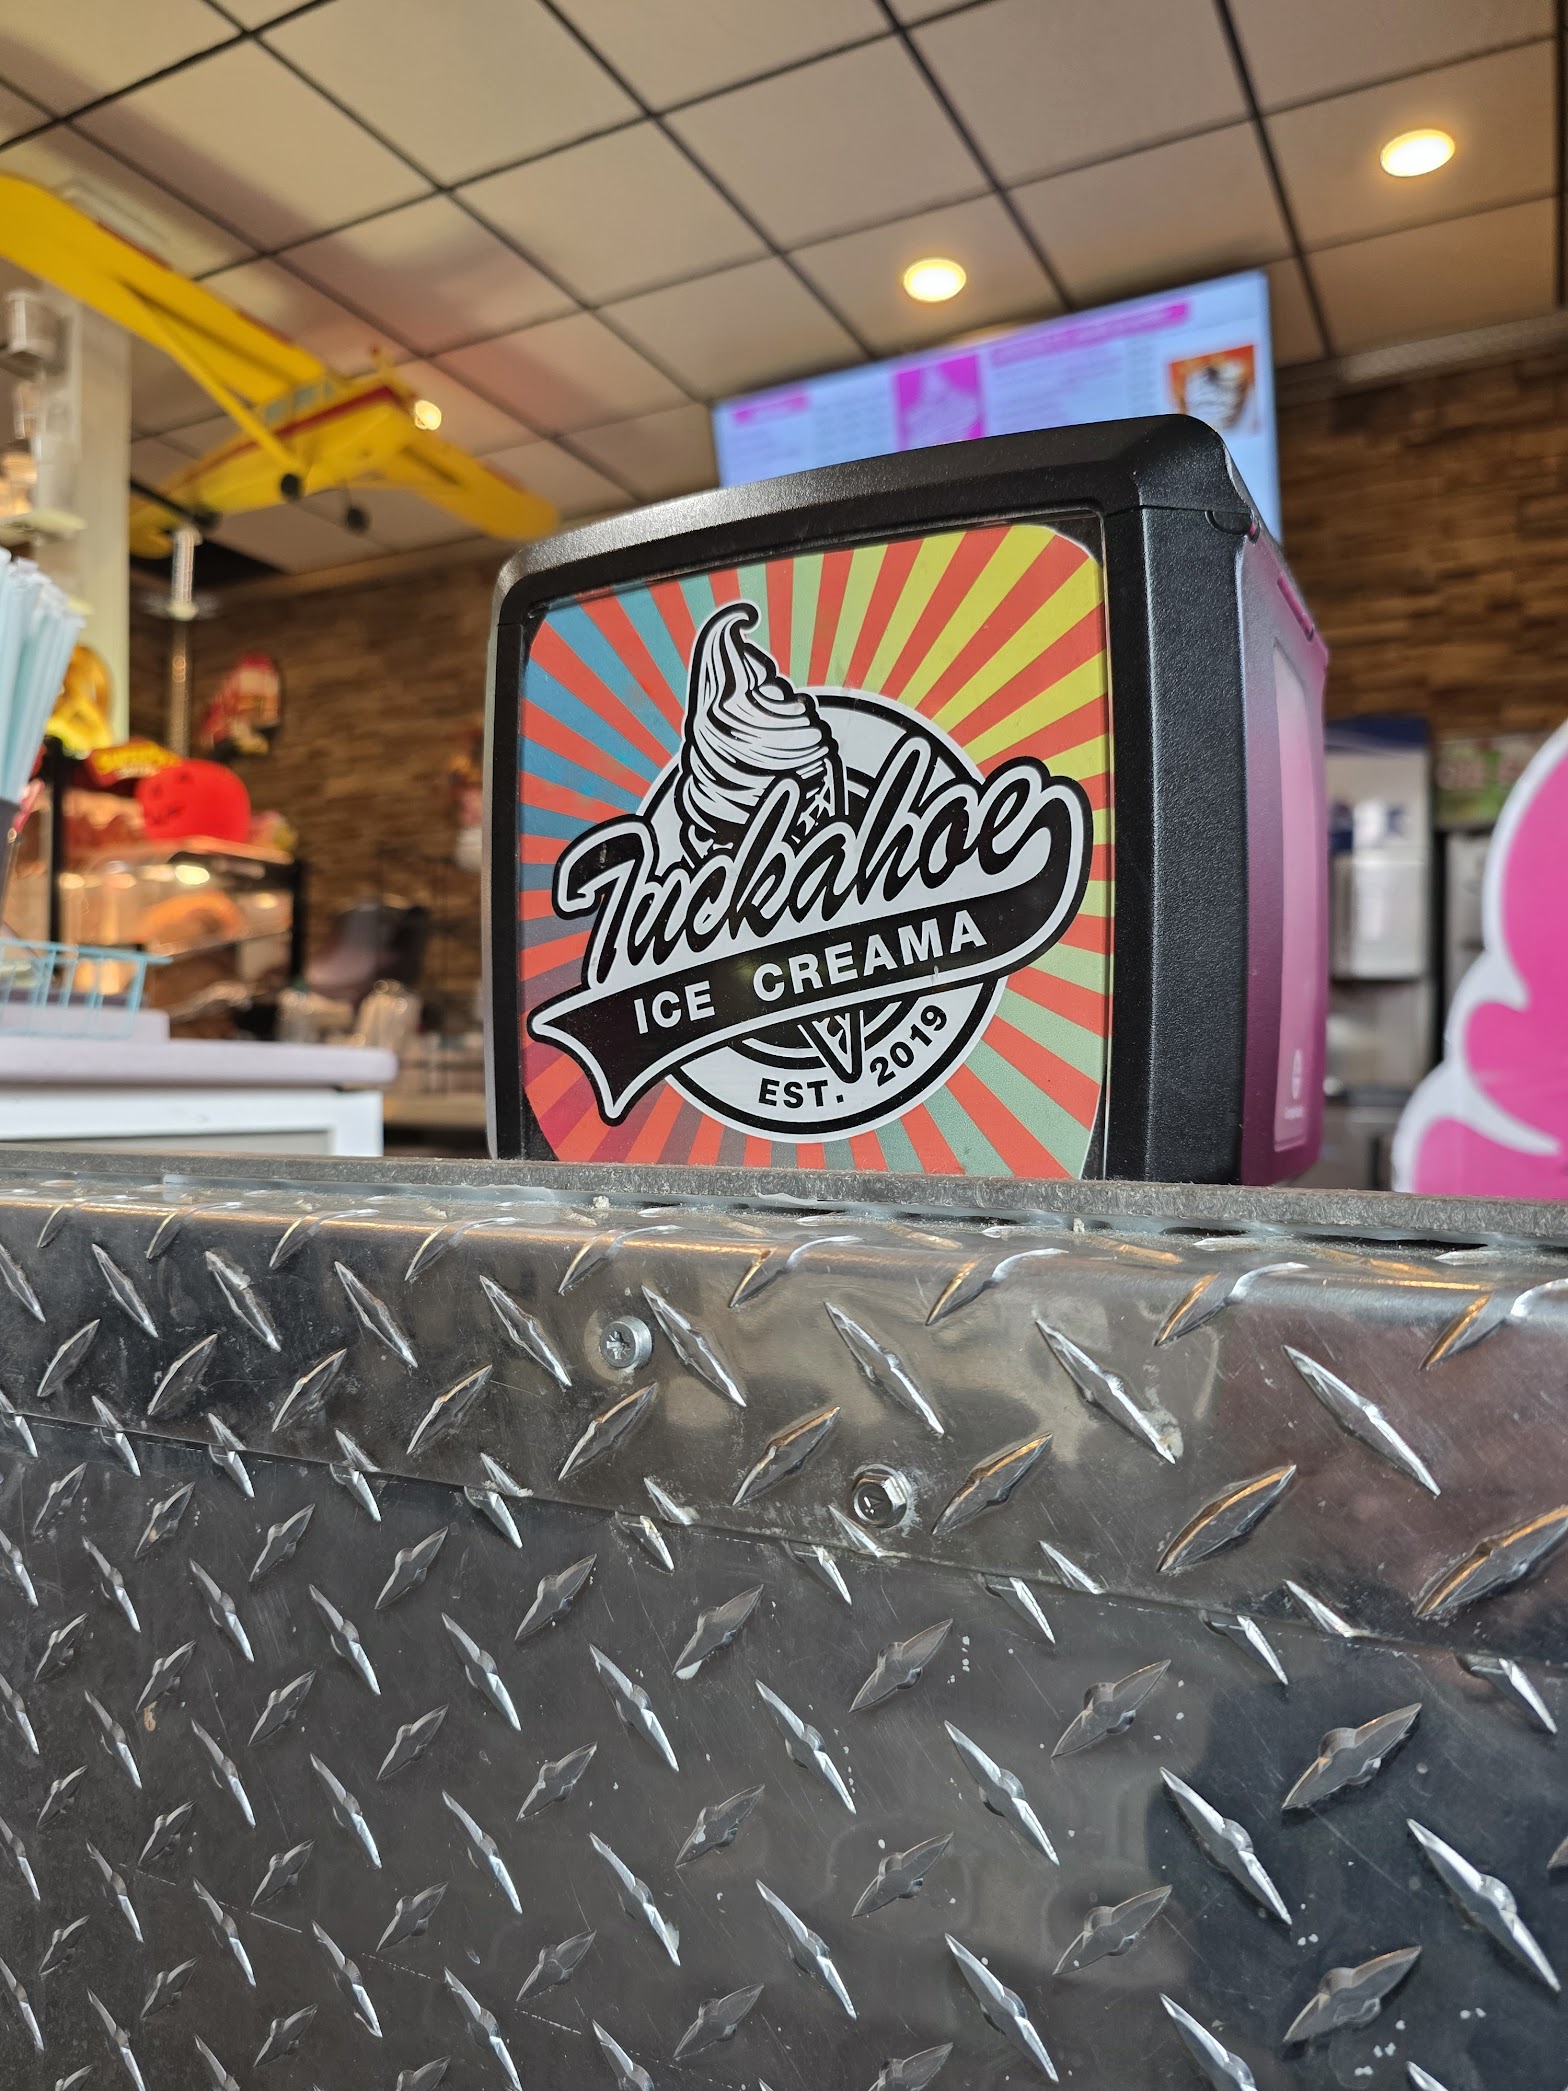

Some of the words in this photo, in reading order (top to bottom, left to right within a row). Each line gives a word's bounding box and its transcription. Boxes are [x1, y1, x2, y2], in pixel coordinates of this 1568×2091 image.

[563, 744, 1074, 985] Tuckahoe
[634, 980, 716, 1034] ICE
[752, 909, 988, 1002] CREAMA
[758, 1077, 844, 1108] EST.
[868, 1004, 948, 1088] 2019
